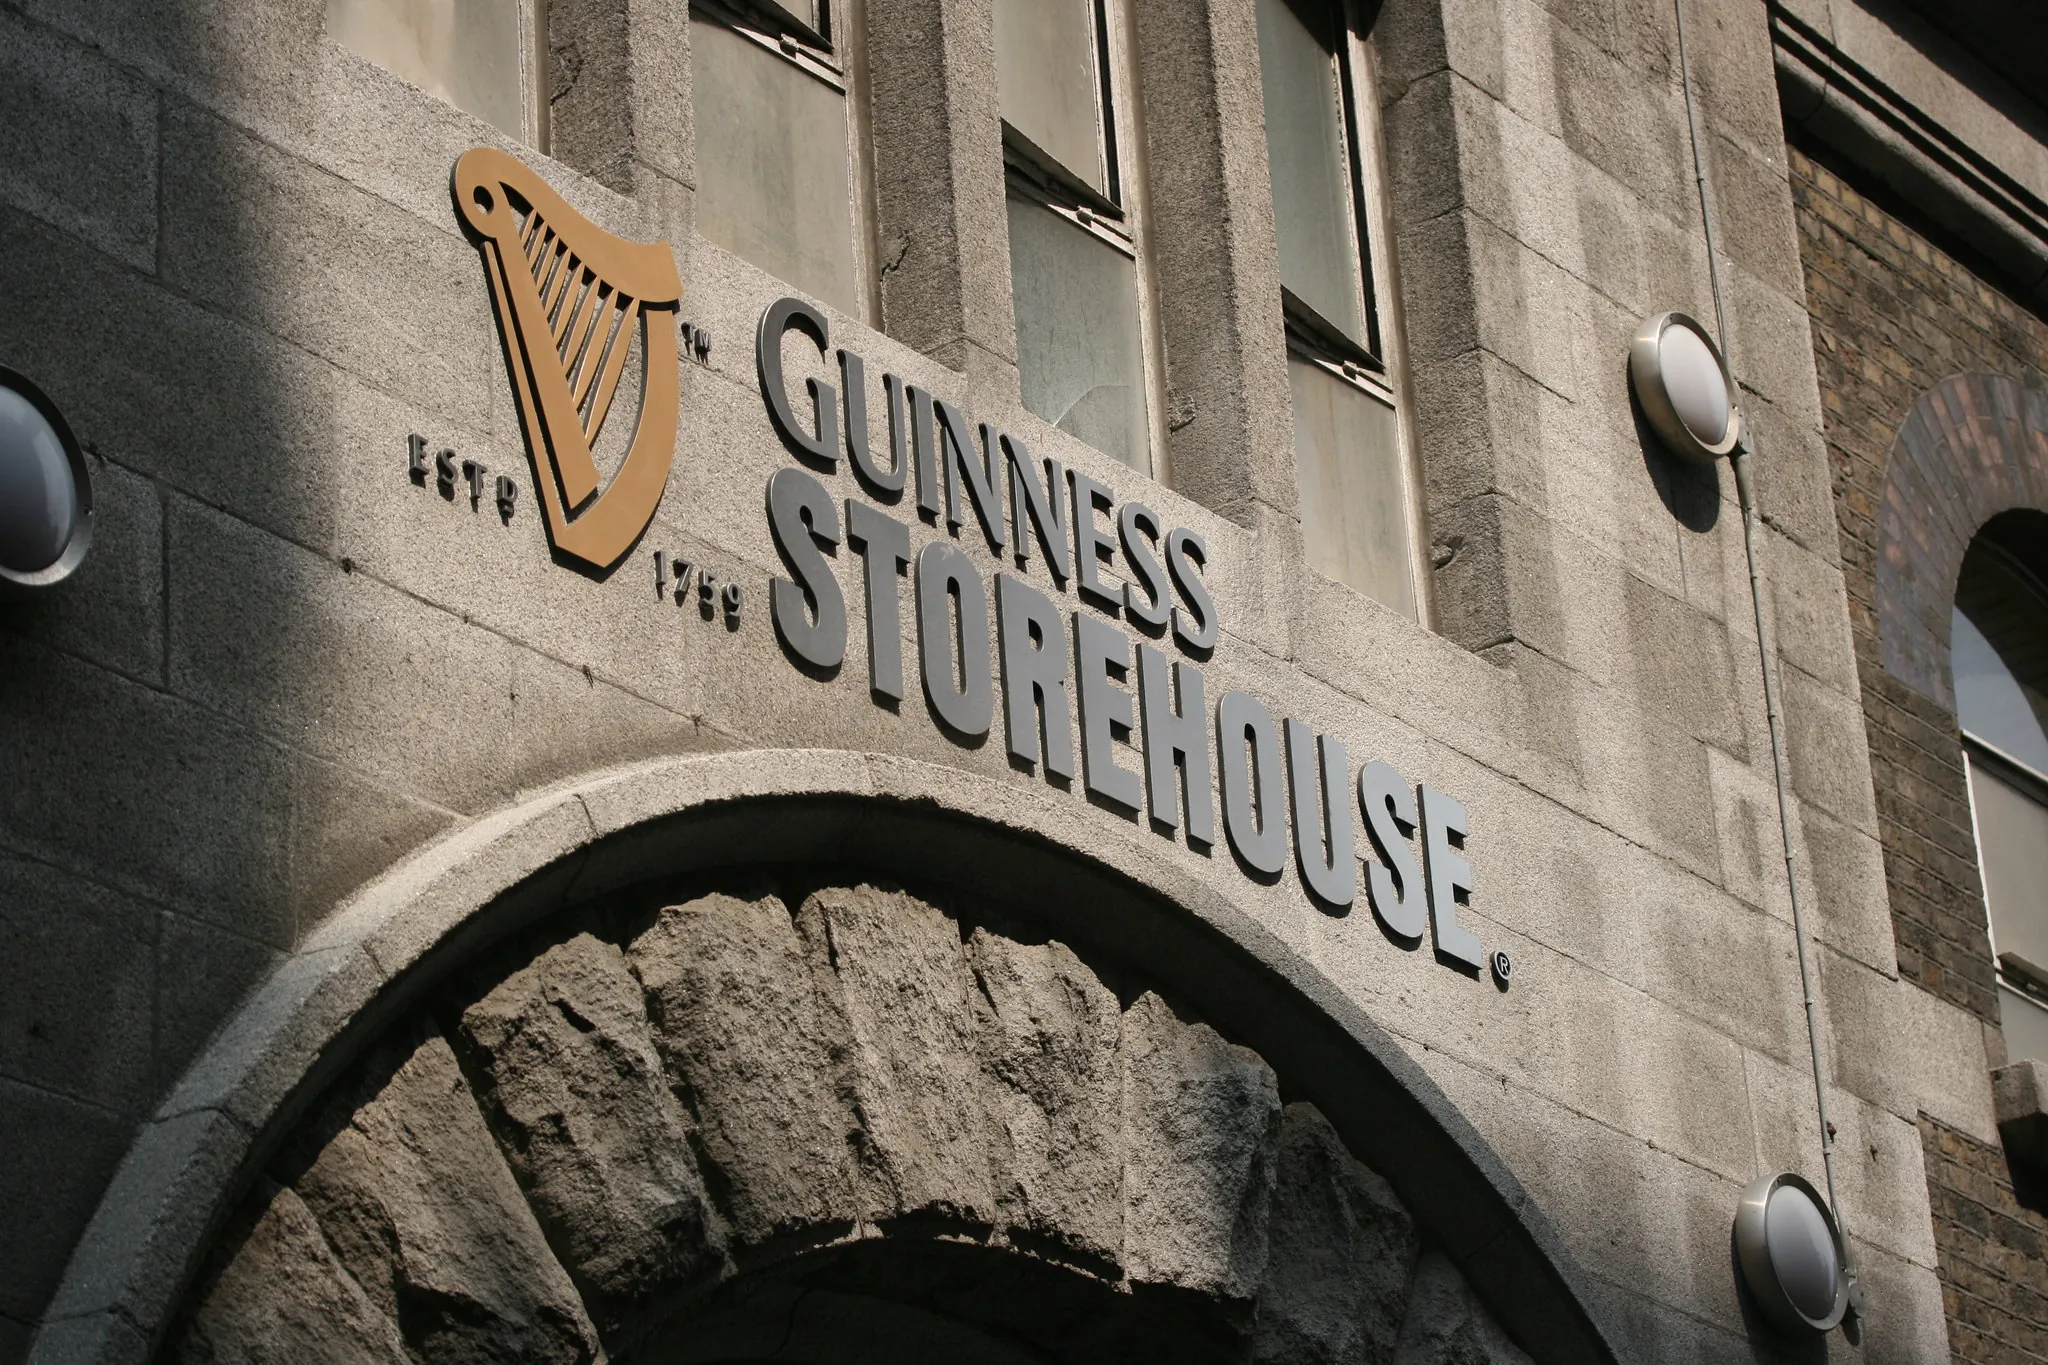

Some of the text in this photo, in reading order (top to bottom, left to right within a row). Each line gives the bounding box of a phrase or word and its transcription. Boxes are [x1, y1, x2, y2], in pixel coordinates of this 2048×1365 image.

[653, 550, 743, 618] 1759
[756, 297, 1218, 649] GUINNESS
[765, 467, 1482, 969] STOREHOUSE
